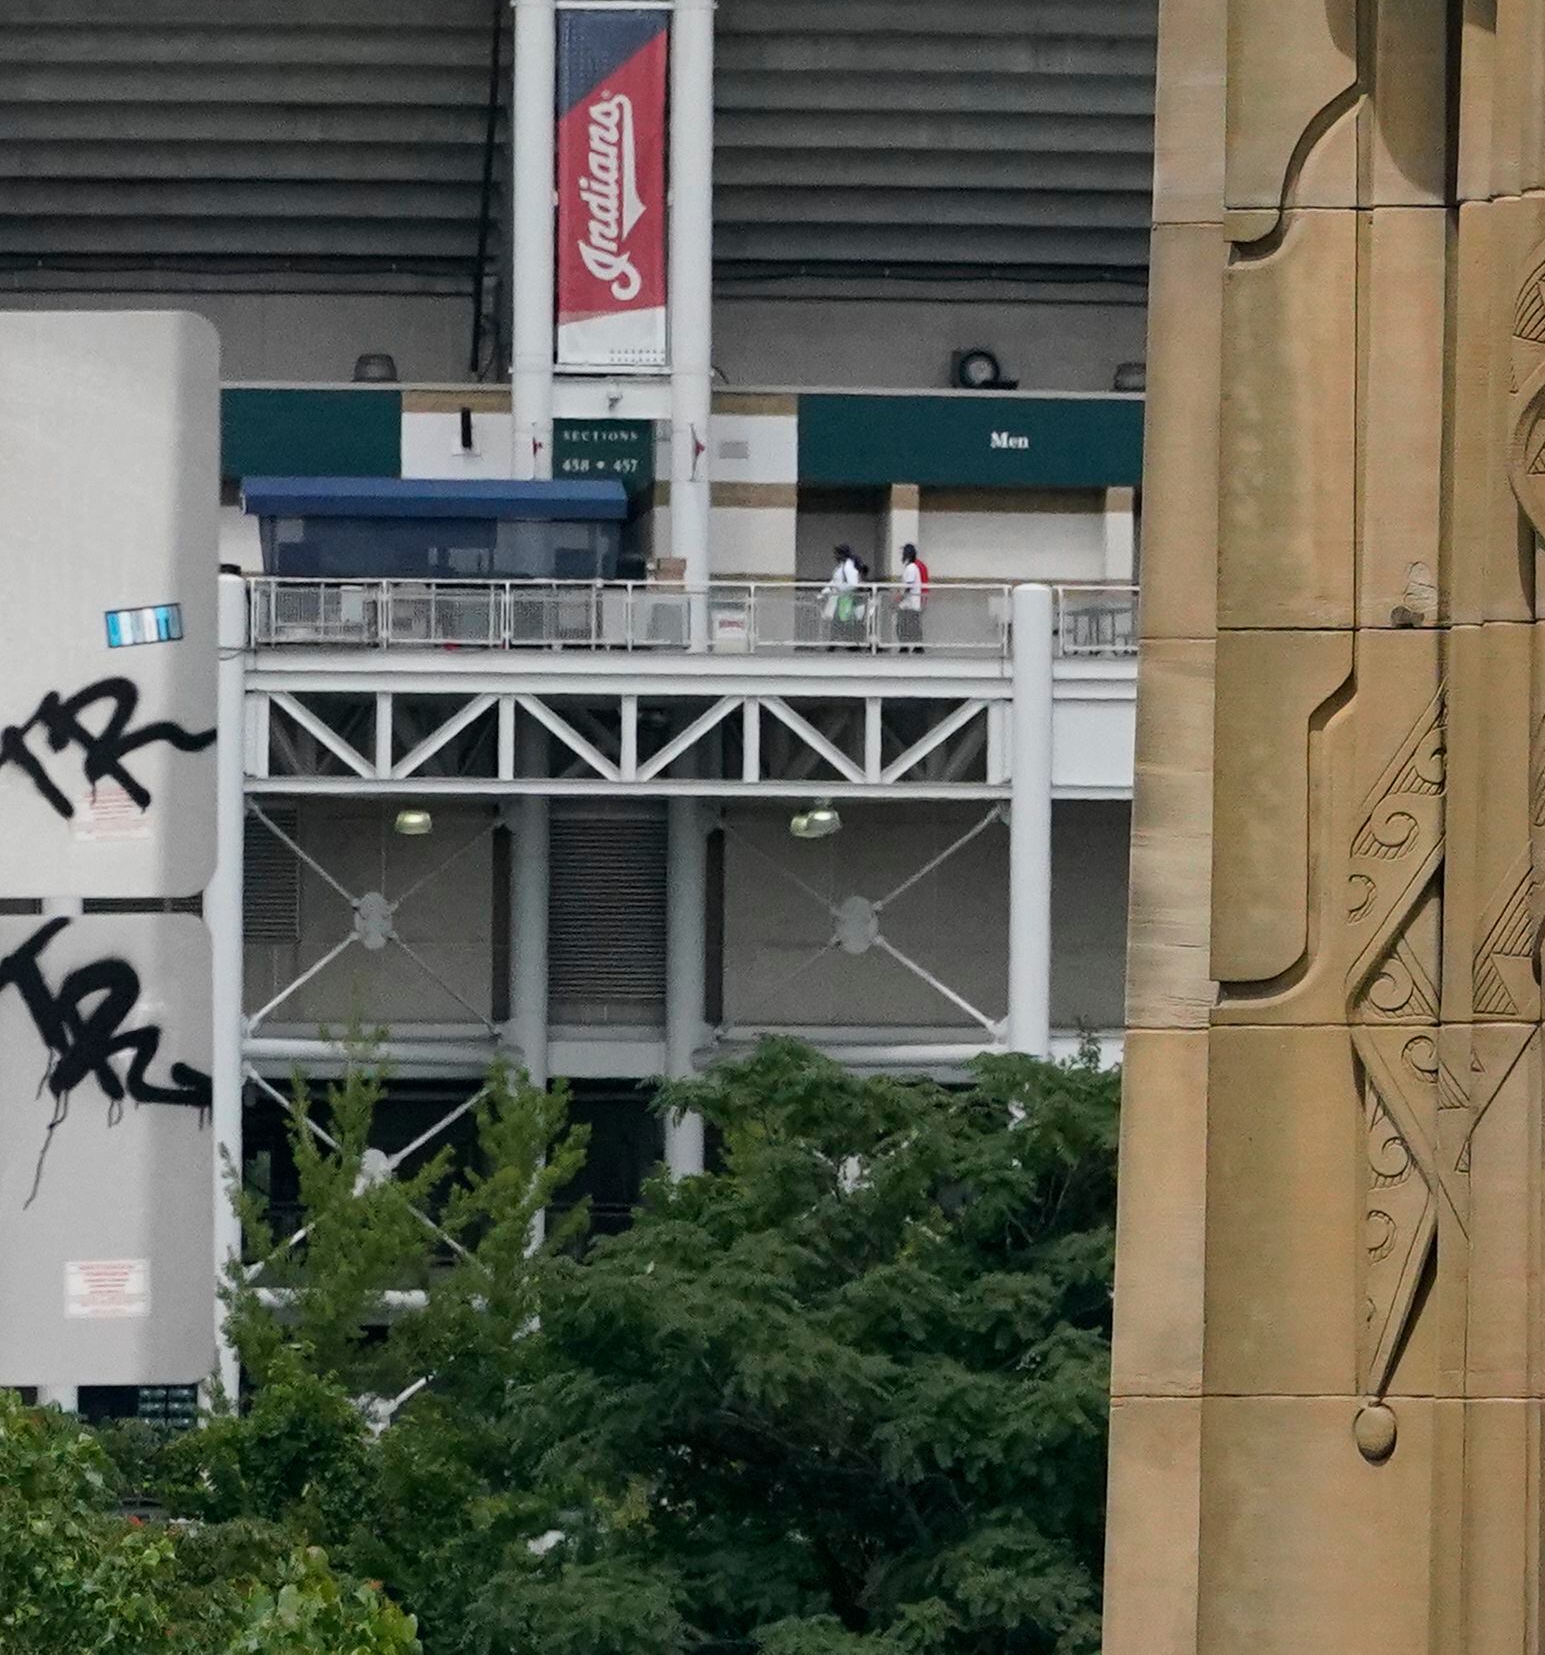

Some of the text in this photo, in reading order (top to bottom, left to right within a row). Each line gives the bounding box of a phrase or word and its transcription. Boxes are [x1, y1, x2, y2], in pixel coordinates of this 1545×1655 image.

[578, 94, 648, 301] Indians
[563, 430, 639, 442] SECTIONS
[991, 431, 1029, 449] Men
